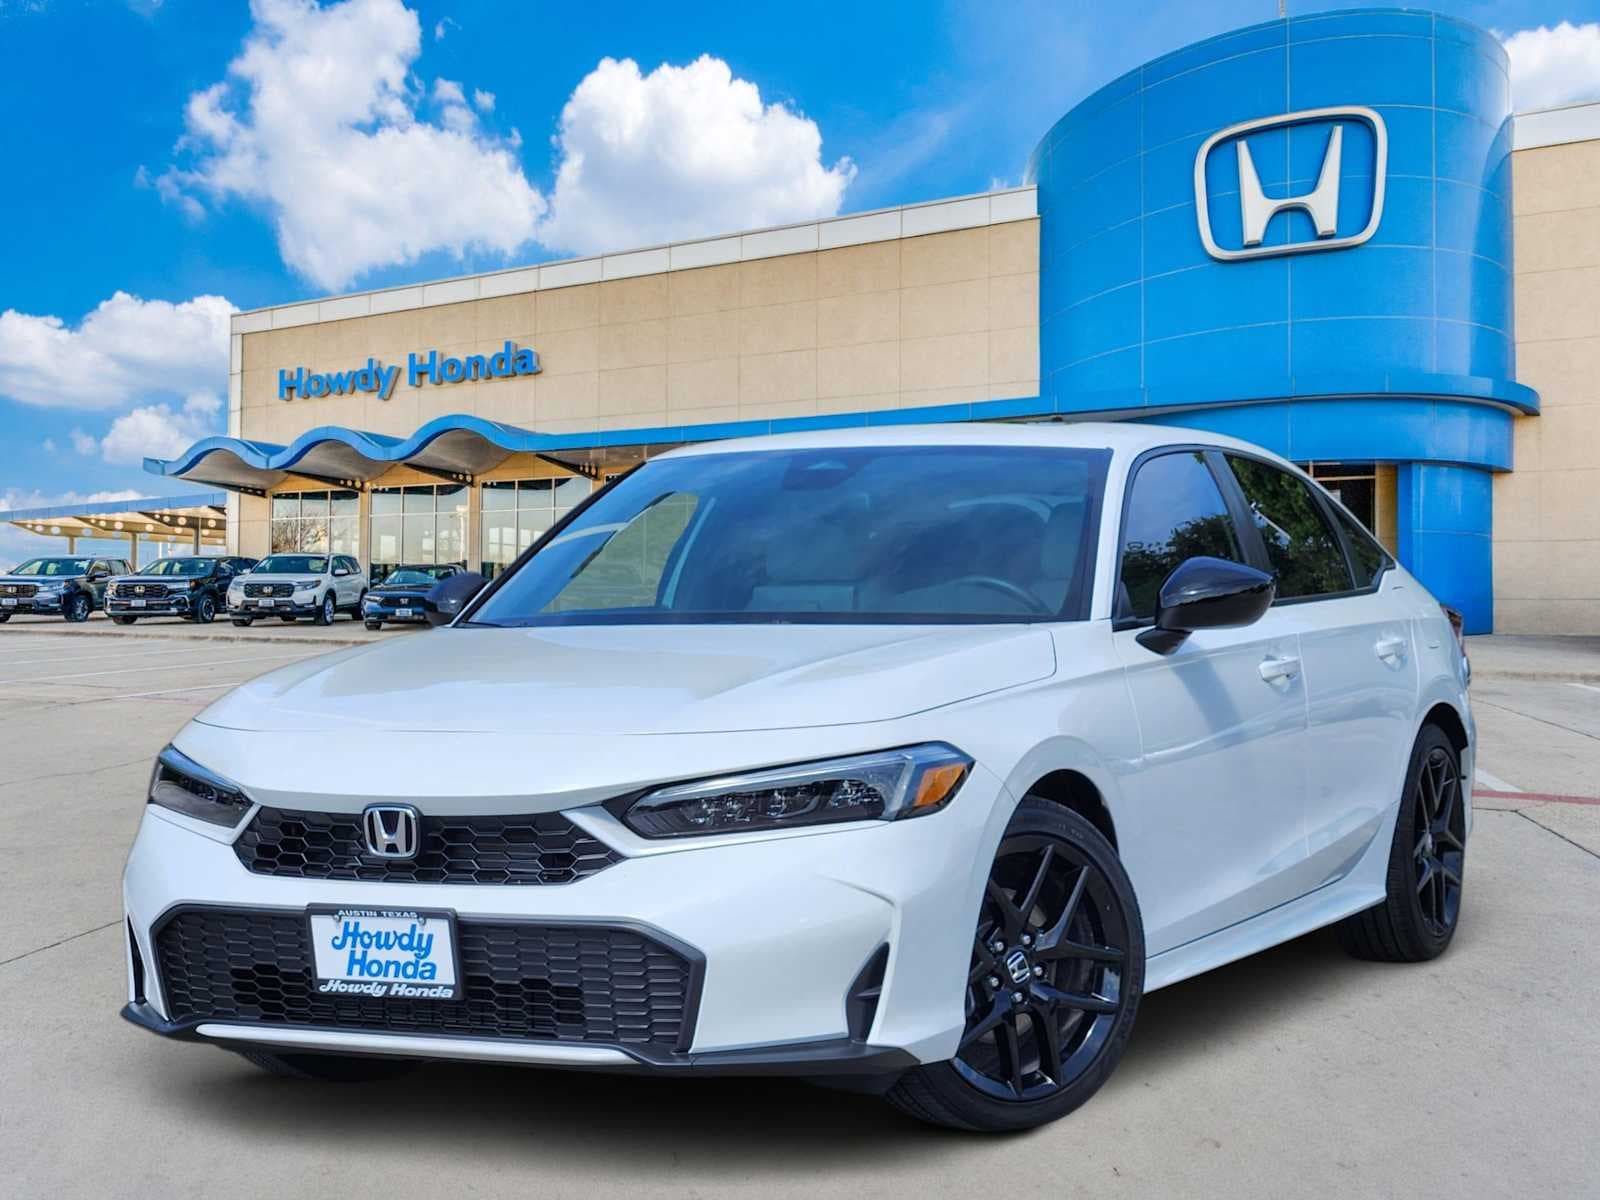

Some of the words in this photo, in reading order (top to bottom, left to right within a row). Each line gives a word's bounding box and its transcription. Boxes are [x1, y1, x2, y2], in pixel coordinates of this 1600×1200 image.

[278, 357, 400, 401] Howdy
[408, 340, 542, 388] Honda
[338, 909, 378, 918] AUSTIN
[381, 911, 418, 919] TEXAS
[331, 921, 434, 960] Howdy
[346, 950, 438, 980] Honda
[319, 979, 387, 998] Howdy
[389, 983, 454, 999] Honda
